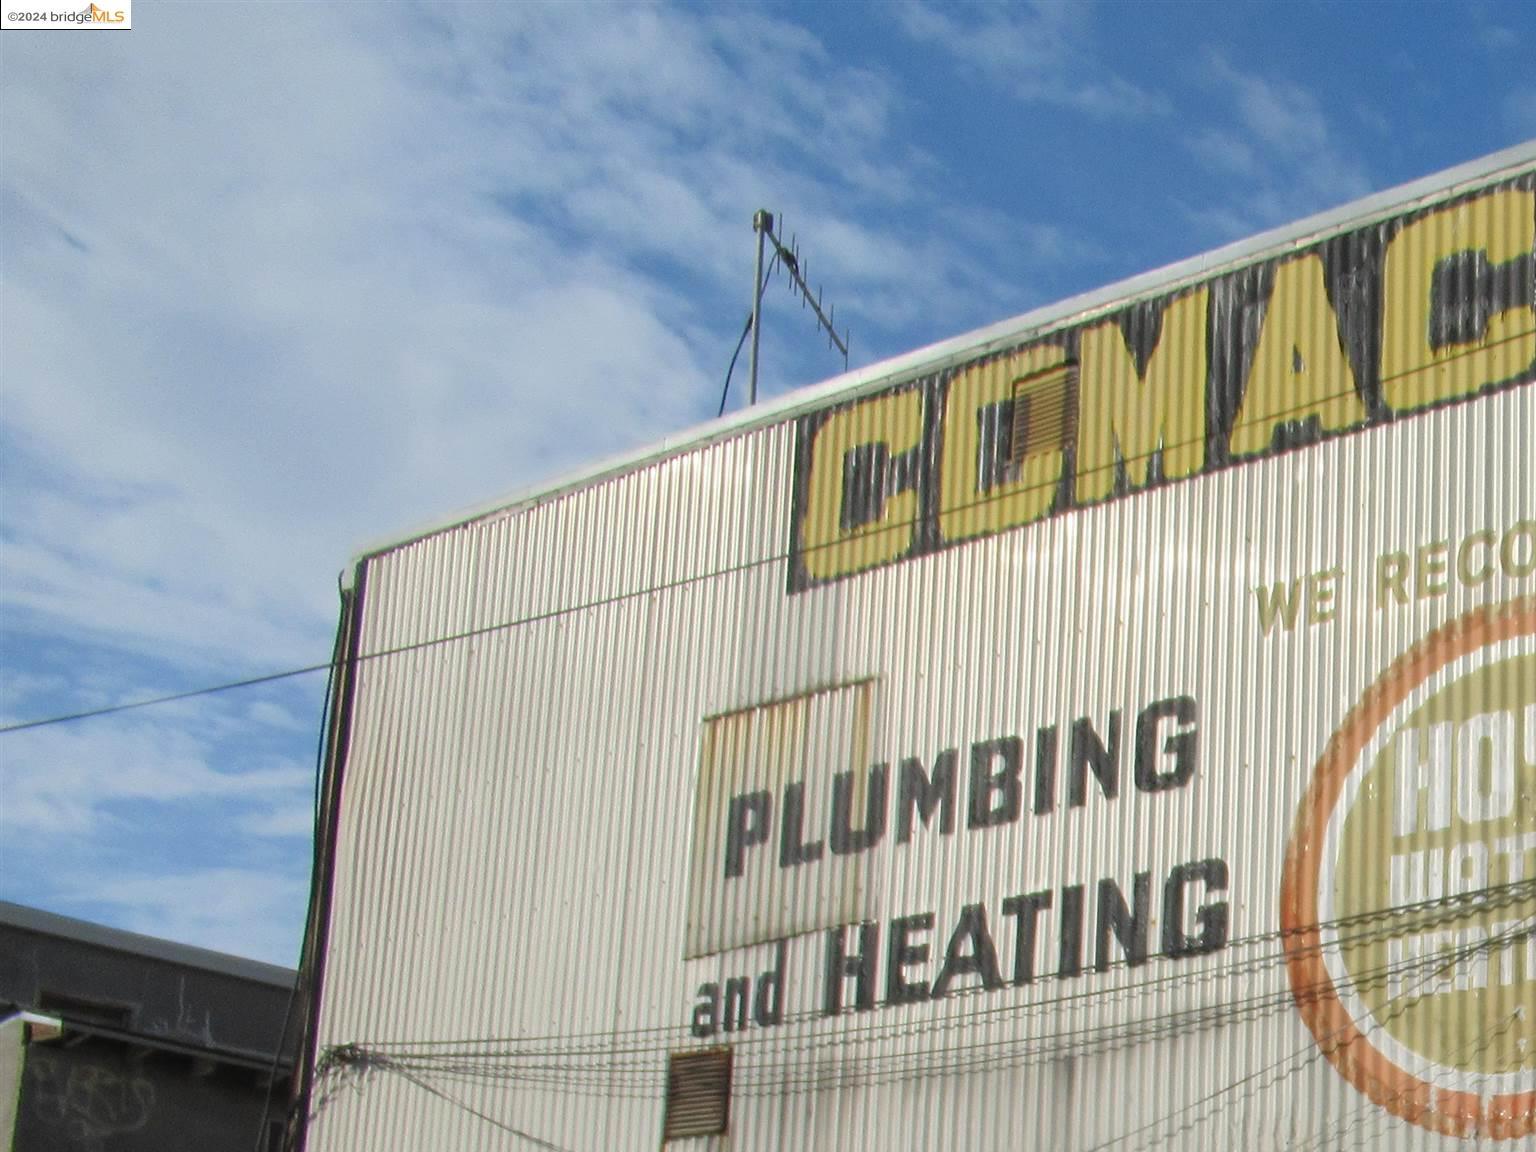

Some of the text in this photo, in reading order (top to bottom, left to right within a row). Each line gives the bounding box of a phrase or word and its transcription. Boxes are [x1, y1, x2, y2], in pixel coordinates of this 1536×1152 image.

[1253, 568, 1343, 637] WE
[724, 695, 1198, 879] PLUMBING
[691, 857, 1230, 1038] and HEATING
